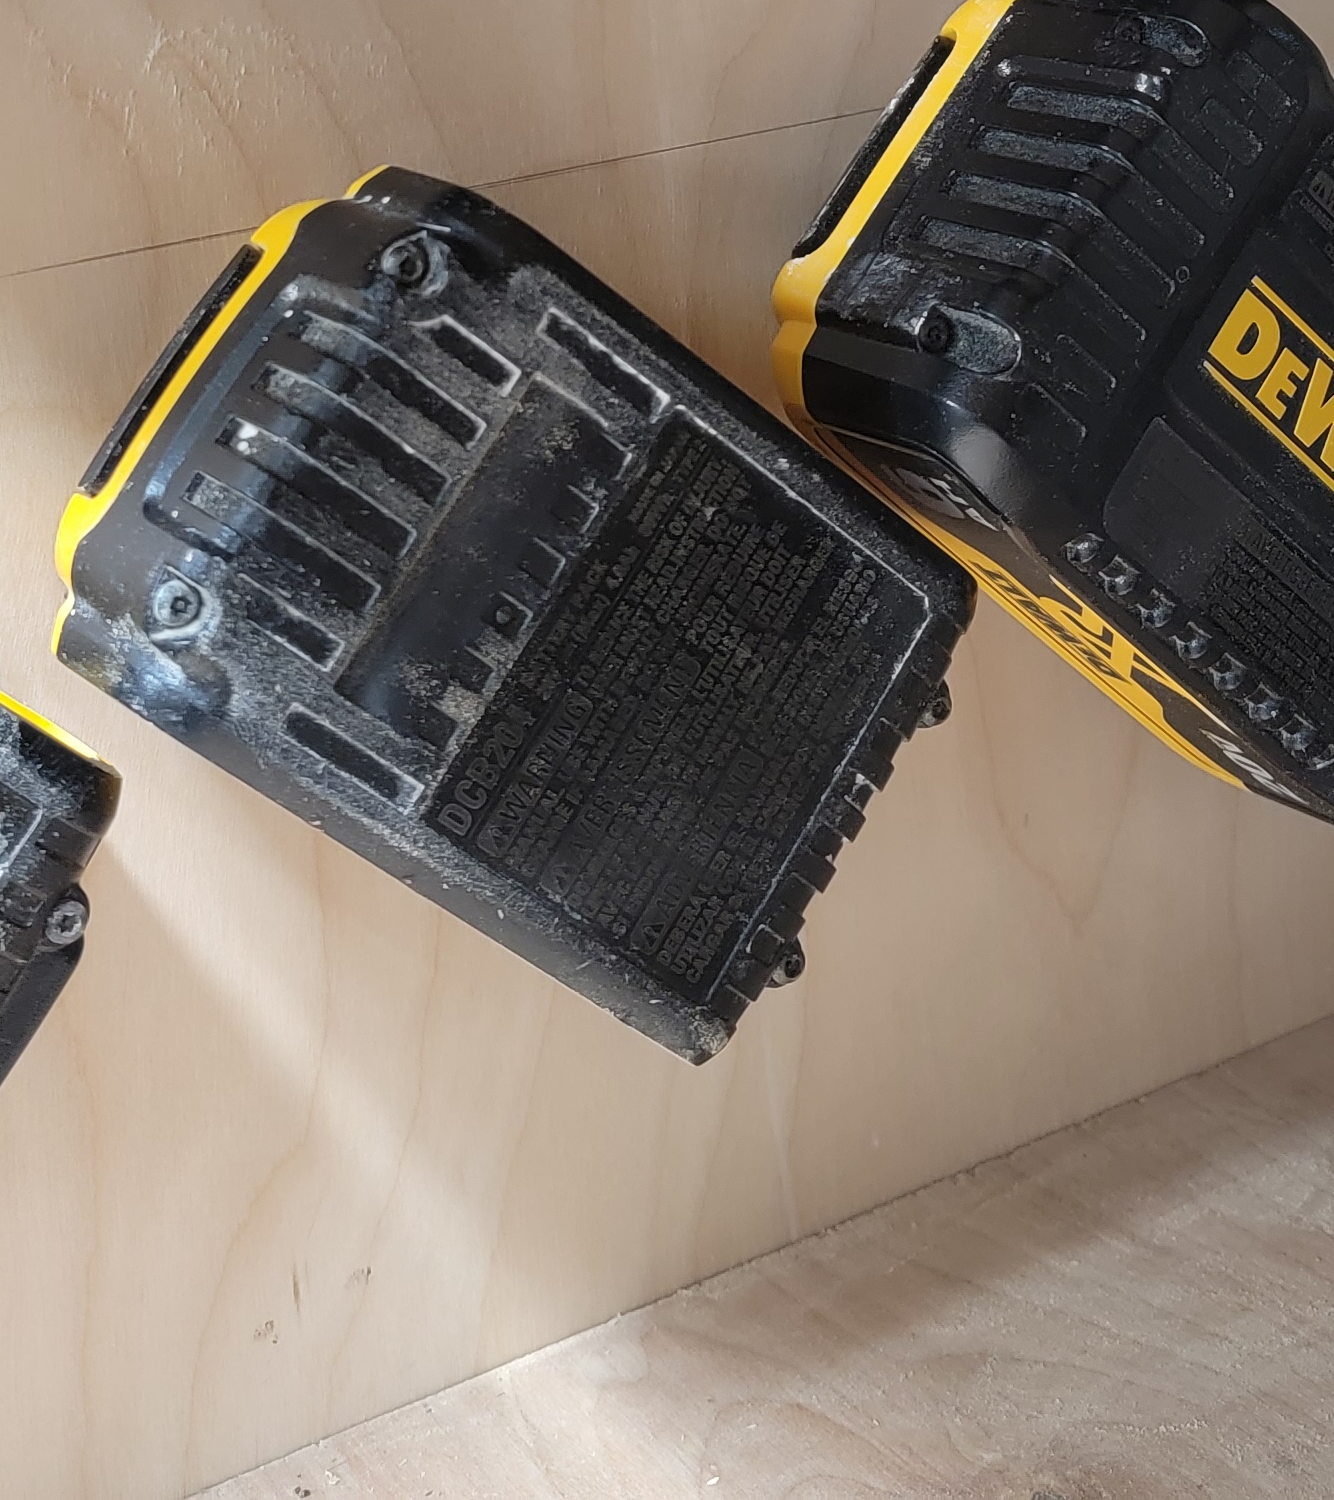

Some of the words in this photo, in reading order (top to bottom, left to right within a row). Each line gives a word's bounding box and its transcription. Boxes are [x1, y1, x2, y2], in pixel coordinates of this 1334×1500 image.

[683, 593, 723, 646] POUR
[699, 606, 737, 656] TOUT
[972, 561, 1132, 684] DEWALT
